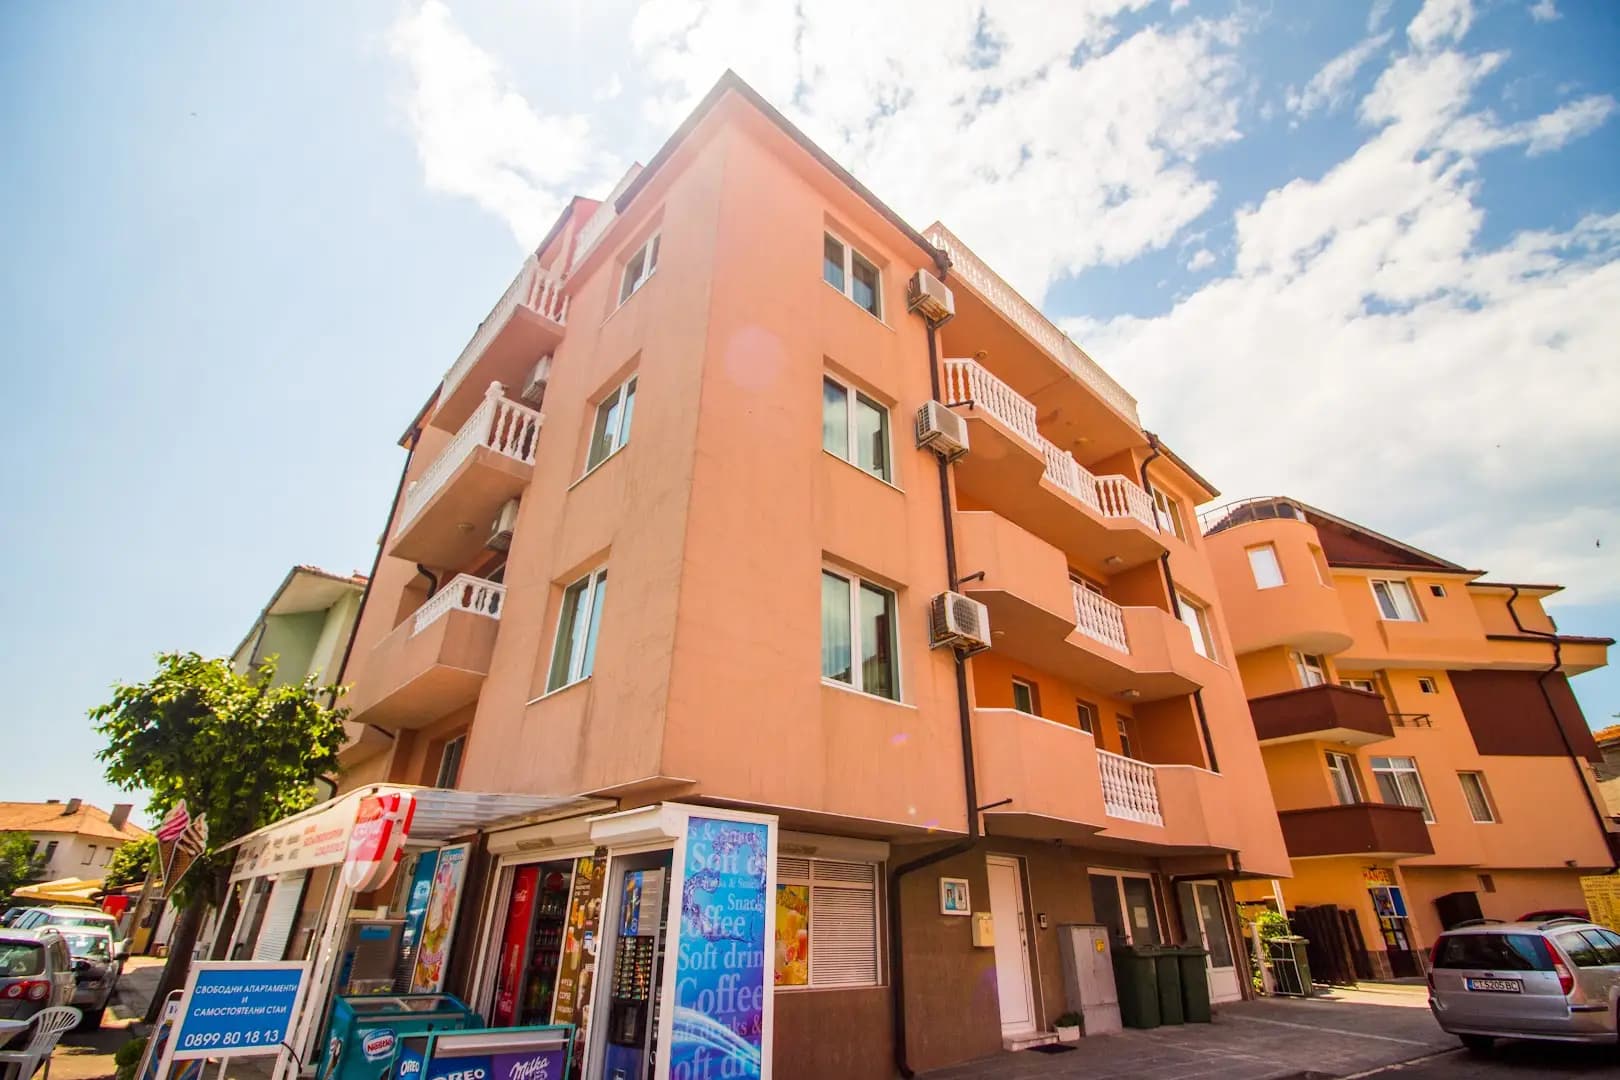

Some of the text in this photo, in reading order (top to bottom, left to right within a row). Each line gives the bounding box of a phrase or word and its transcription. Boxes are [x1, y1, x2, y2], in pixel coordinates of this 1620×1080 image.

[691, 842, 739, 874] Soft
[679, 942, 718, 971] Soft
[195, 984, 298, 995] СВОБОДНИ АПАРТАМЕНТИ
[676, 973, 764, 1016] Coffee
[241, 996, 249, 1004] И
[193, 1005, 287, 1017] САМОСТОЯТЕЛНИ СТАИ
[184, 1029, 279, 1047] 0899 80 18 13
[400, 1059, 420, 1076] OREO
[431, 1068, 486, 1080] REO
[509, 1055, 550, 1080] Milka
